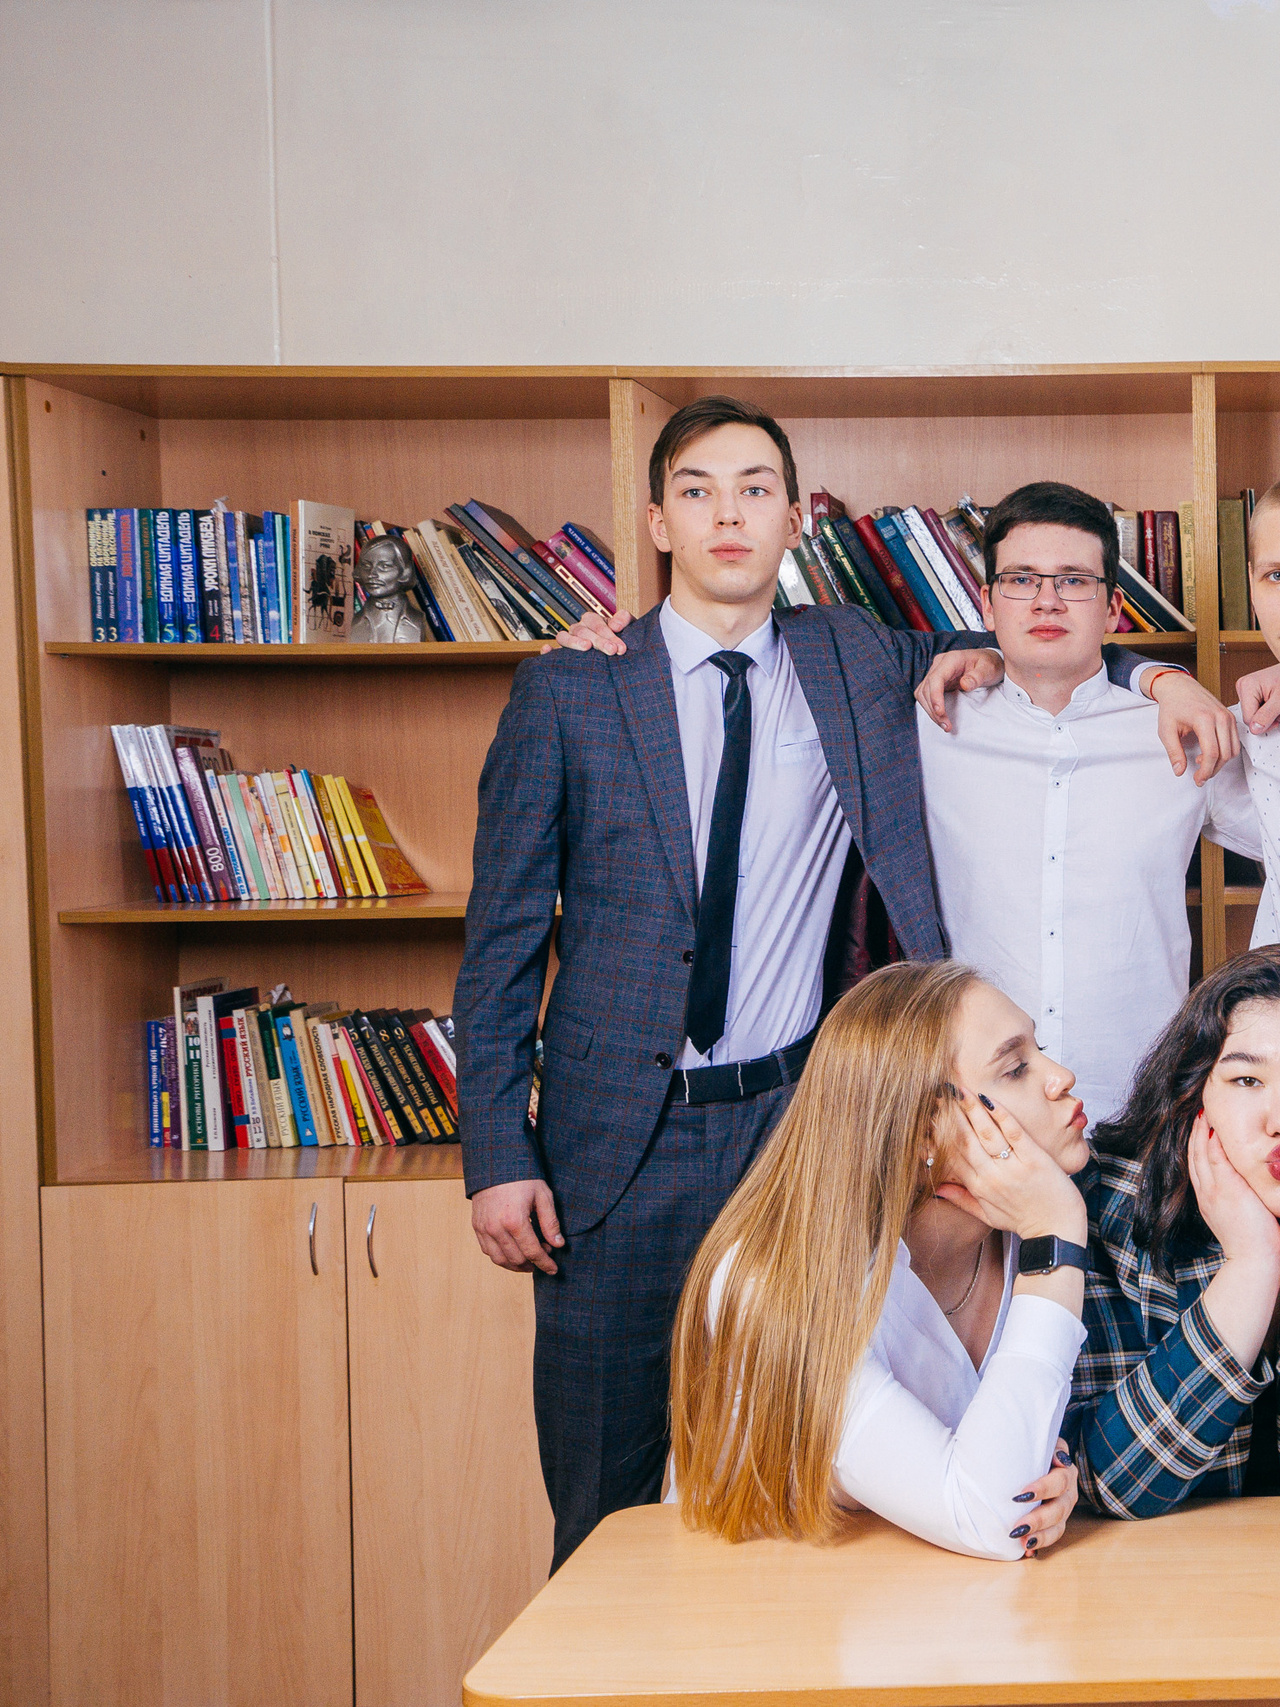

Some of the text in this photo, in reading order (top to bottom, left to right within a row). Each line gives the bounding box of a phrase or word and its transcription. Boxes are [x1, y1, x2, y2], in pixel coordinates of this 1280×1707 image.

[94, 513, 104, 566] НА БЕССМЕРТИЕ
[107, 513, 117, 566] НА БЕССМЕРТИЕ
[120, 515, 133, 577] ЗВОН КЛИНКА
[200, 516, 218, 591] УРОКИ ЛИКБЕЗА
[156, 512, 174, 602] ЕДИНАЯ ЦИТАДЕЛЬ
[178, 512, 196, 602] ЕДИНАЯ ЦИТАДЕЛЬ
[96, 627, 105, 642] 3
[109, 626, 118, 641] 3
[164, 623, 174, 642] 5
[186, 624, 196, 642] 5
[210, 625, 220, 640] 4
[206, 846, 224, 872] 800
[188, 1036, 200, 1046] 10
[235, 1016, 252, 1077] РУССКИЙ ЯЗЫК
[379, 1029, 390, 1043] 8
[394, 1026, 406, 1041] 9
[190, 1049, 200, 1059] 11
[291, 1065, 301, 1085] ЯЗЫК
[310, 1025, 342, 1138] РУССКАЯ НАРОДНАЯ СЛОВЕСНОСТЬ
[192, 1061, 202, 1133] ОСНОВЫ РИТОРИКИ
[272, 1080, 289, 1136] РУССКИЙ ЯЗЫК
[295, 1086, 309, 1121] РУССКИЙ
